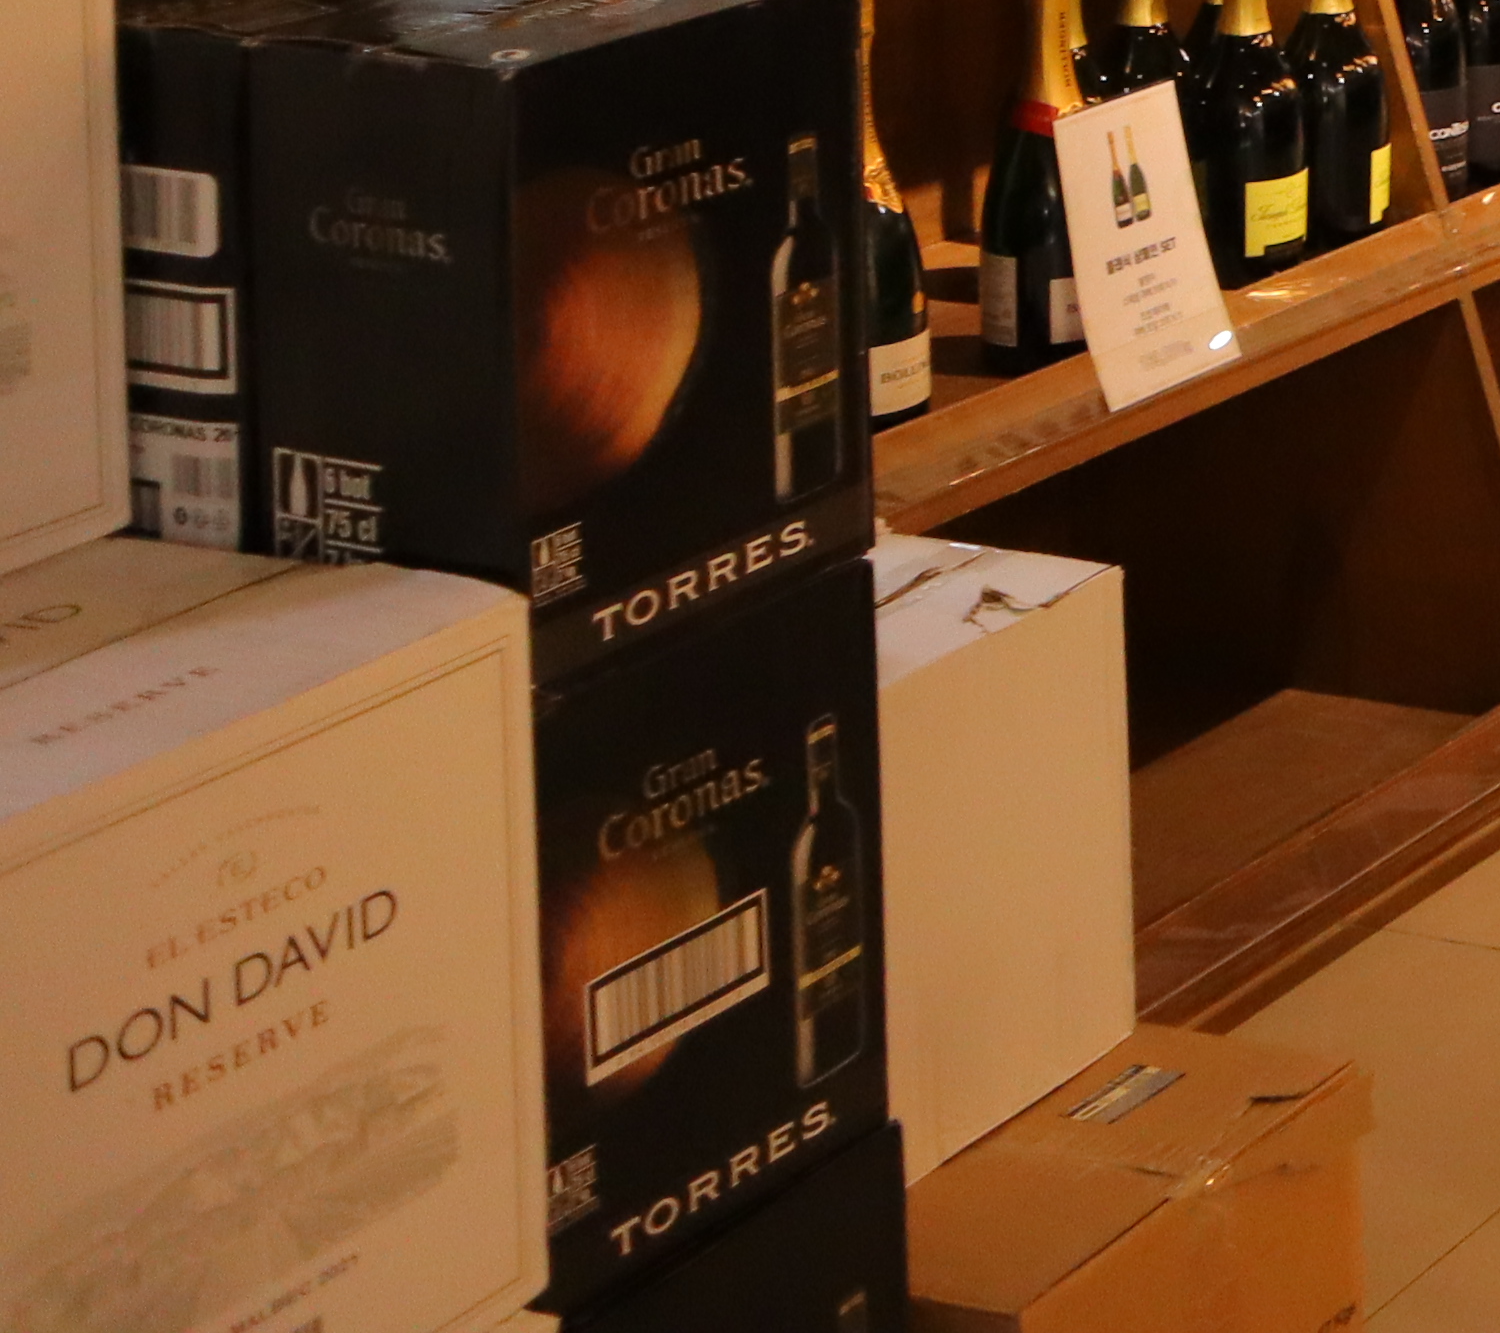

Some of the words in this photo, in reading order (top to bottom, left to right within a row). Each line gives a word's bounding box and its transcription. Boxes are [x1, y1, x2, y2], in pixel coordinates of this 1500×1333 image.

[586, 157, 748, 233] Coronas
[592, 520, 807, 642] TORRES
[599, 758, 764, 859] Coronas
[196, 865, 327, 945] ESTECO
[68, 977, 212, 1094] DON
[233, 889, 398, 1007] DAVID
[152, 999, 331, 1112] RESERVE
[611, 1101, 830, 1256] TORRES
